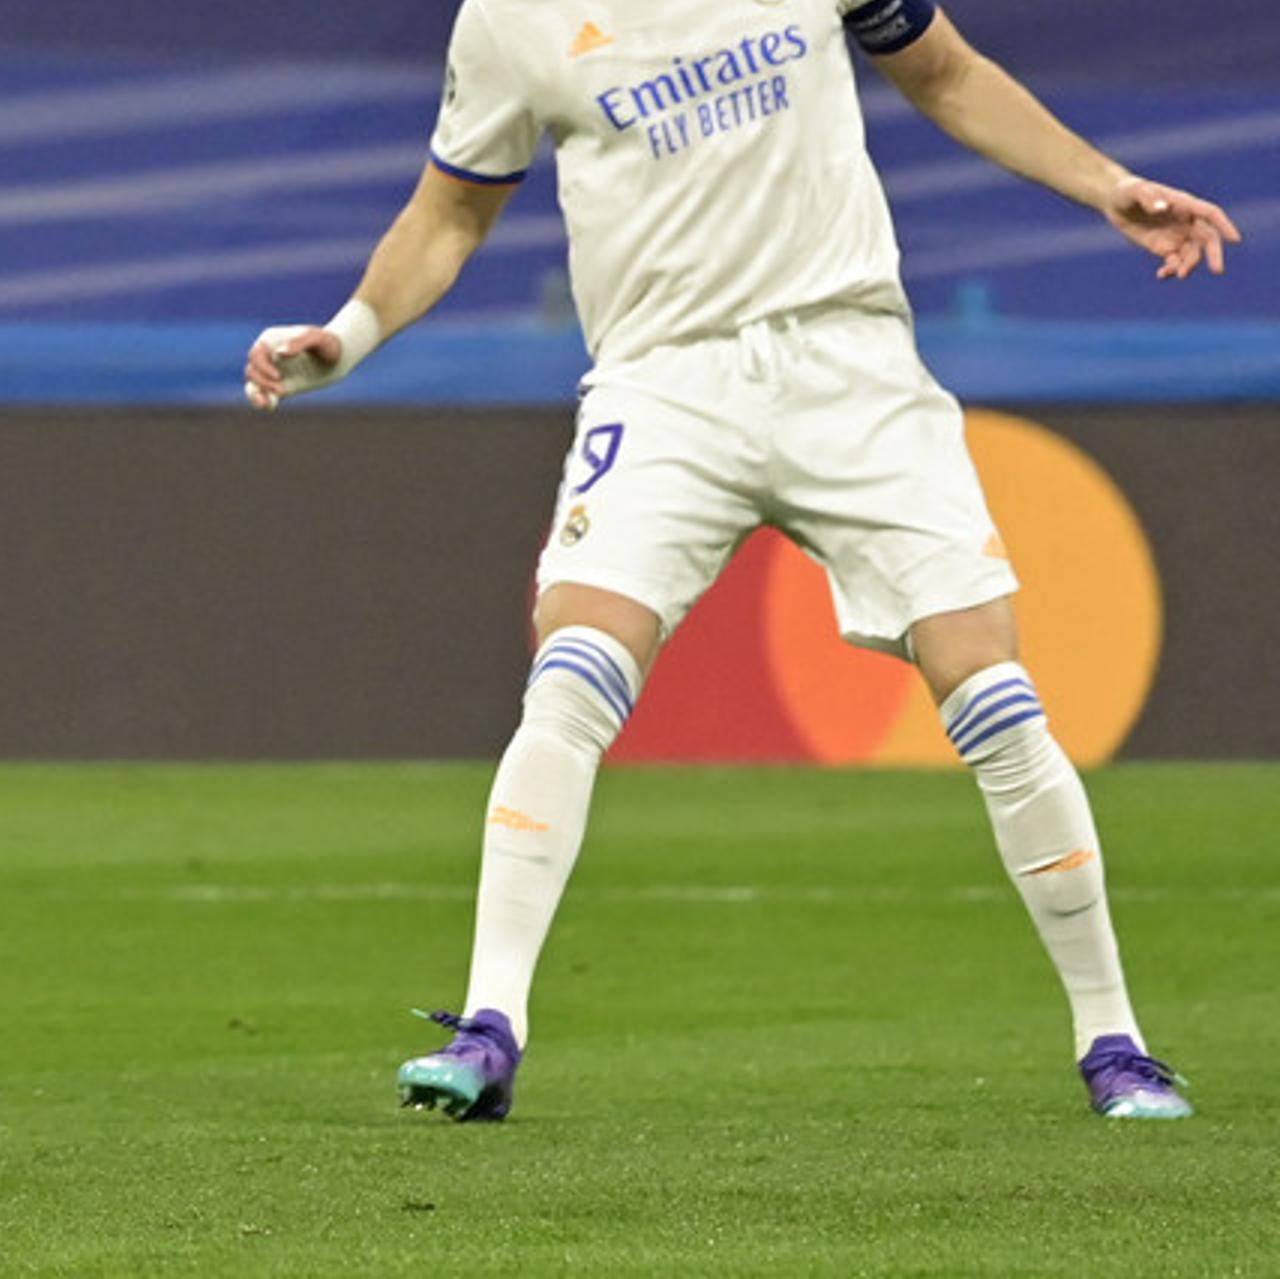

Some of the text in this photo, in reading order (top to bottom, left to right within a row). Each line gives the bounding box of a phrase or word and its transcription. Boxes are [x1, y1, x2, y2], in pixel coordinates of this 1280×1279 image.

[595, 24, 808, 132] Emirates
[647, 74, 790, 161] FLY BETTER
[573, 422, 624, 494] 9
